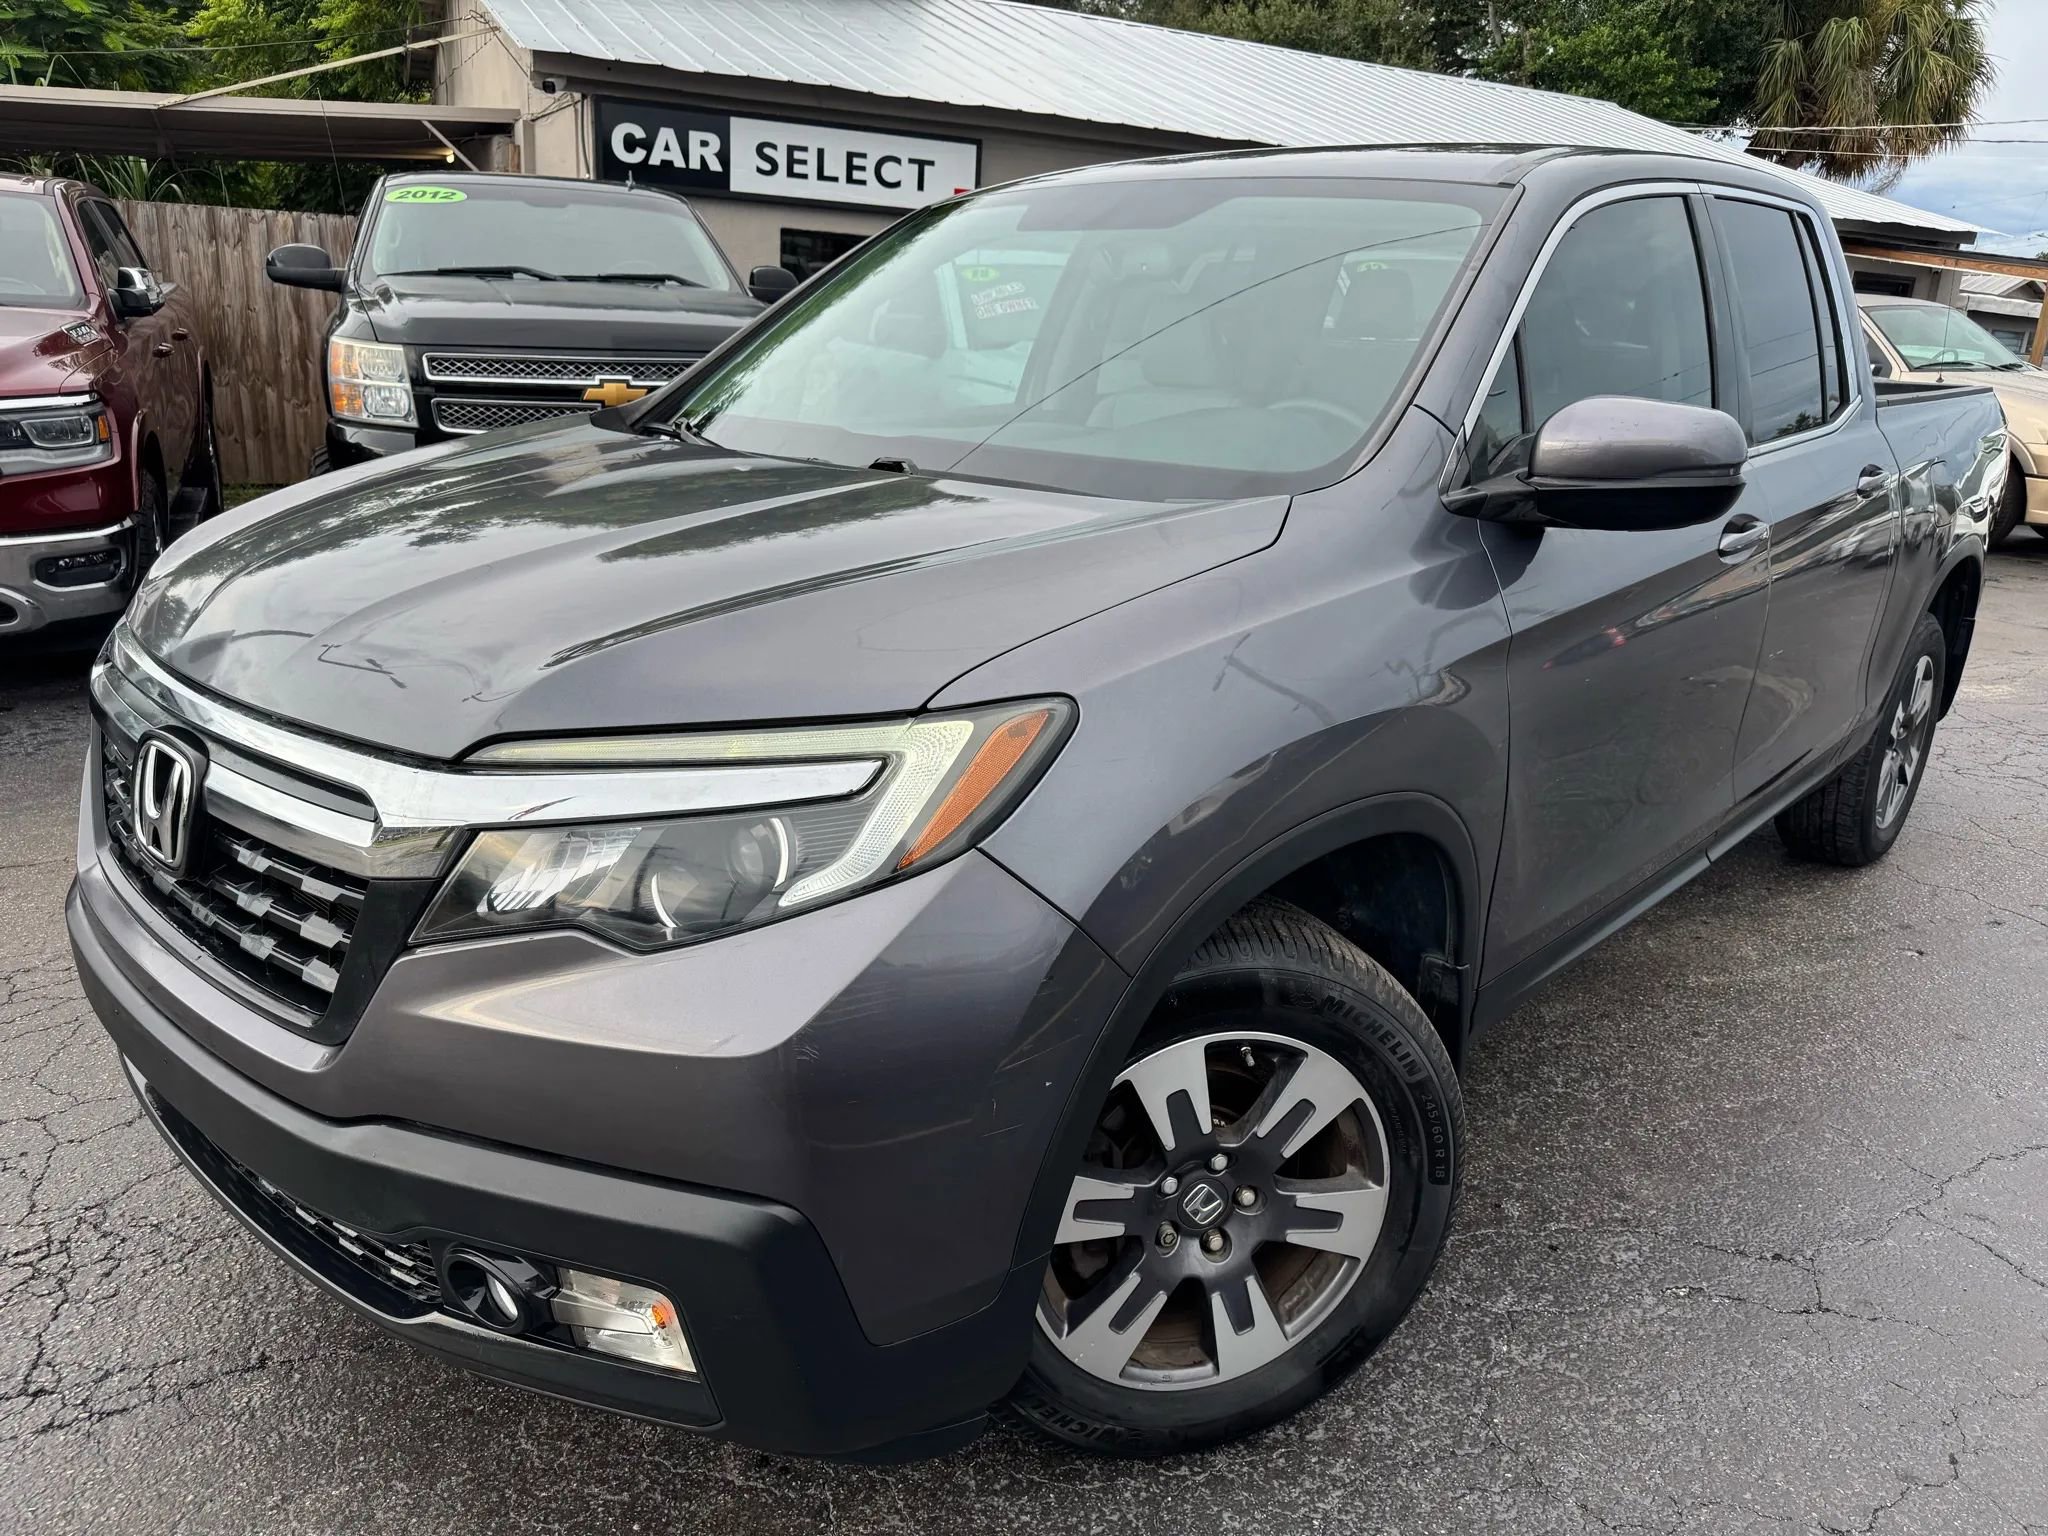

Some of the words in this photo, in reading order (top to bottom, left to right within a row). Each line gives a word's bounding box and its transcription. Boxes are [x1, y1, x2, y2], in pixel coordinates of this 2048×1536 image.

[611, 122, 723, 172] CAR
[755, 141, 935, 192] SELECT
[395, 190, 456, 200] 2012
[1322, 995, 1421, 1078] MICHELIN
[1421, 1094, 1444, 1144] 245/60
[1434, 1151, 1445, 1159] R
[1434, 1165, 1446, 1179] 18
